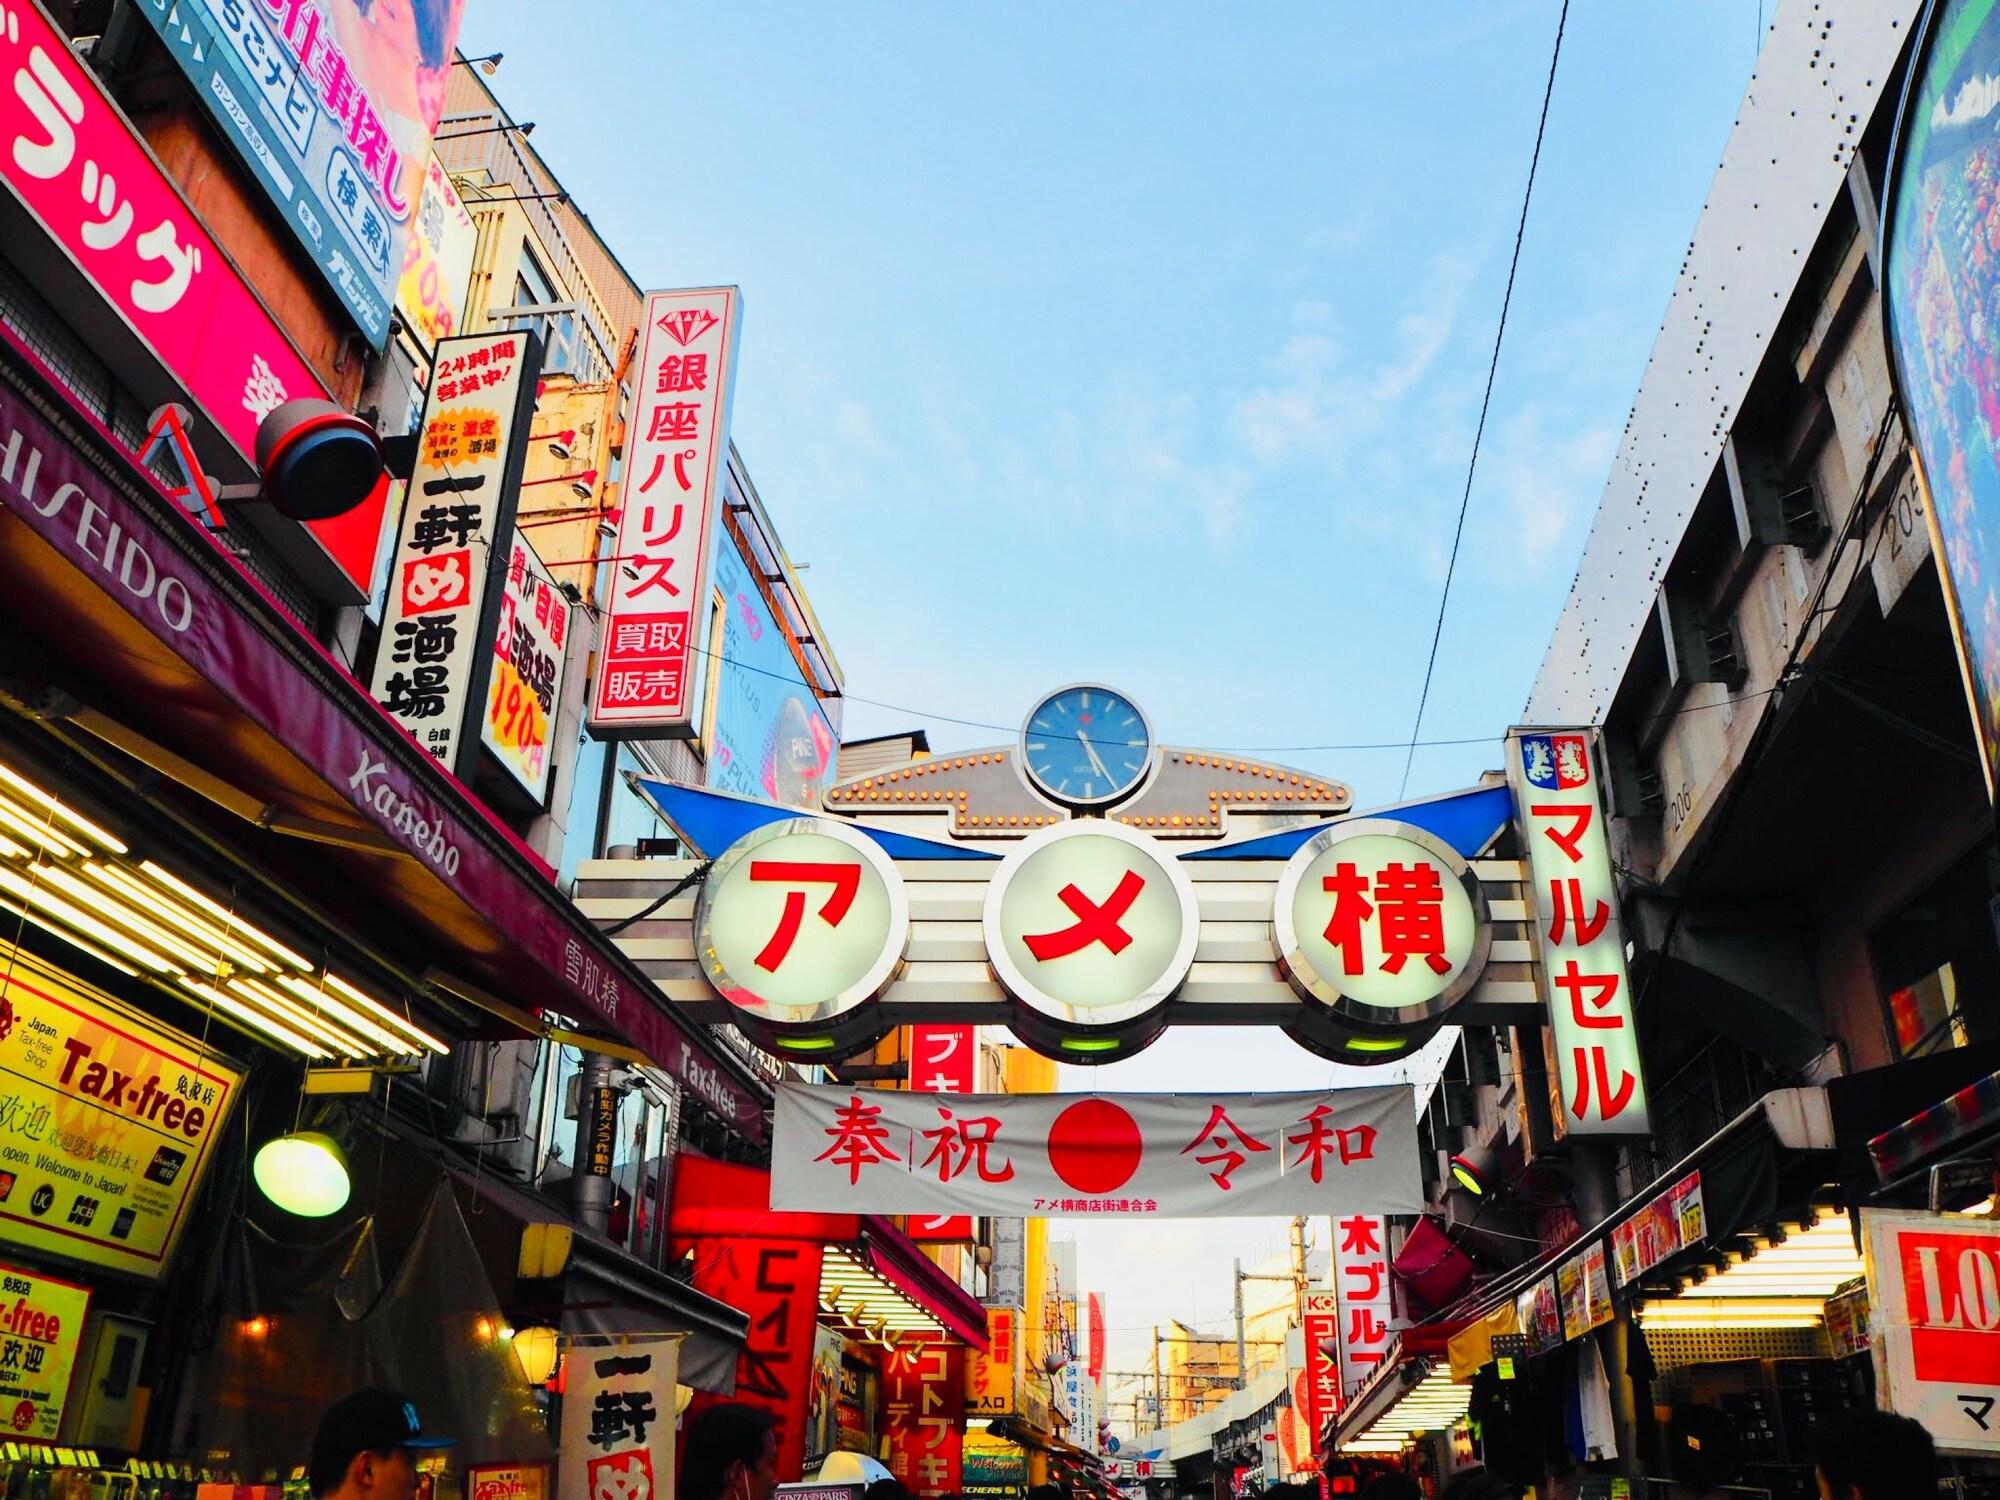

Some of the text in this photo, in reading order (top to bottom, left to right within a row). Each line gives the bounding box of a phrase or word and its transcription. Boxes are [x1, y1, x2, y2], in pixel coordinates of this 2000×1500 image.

[0, 3, 201, 313] ラッグ
[337, 167, 383, 254] 検索
[437, 365, 511, 402] 営業中!
[438, 340, 516, 380] 24時間
[625, 353, 708, 599] 銀座パリス
[381, 475, 485, 718] 一軒め酒場
[615, 622, 683, 652] 買取
[608, 670, 679, 702] 販売
[349, 751, 459, 877] Kanebo
[748, 860, 1452, 976] アメ横
[1531, 804, 1637, 1121] マルセル
[19, 1030, 54, 1055] Tax-free
[28, 1016, 58, 1039] Japan.
[24, 1050, 47, 1070] Shop
[59, 1037, 205, 1137] Tax-free
[681, 1042, 736, 1118] Tax-free
[814, 1096, 1378, 1191] 奉祝 令和
[35, 1155, 81, 1182] Welcome
[83, 1172, 94, 1186] to
[94, 1178, 127, 1198] Japan!
[1033, 1198, 1158, 1214] アメ横商店街連合会
[72, 1206, 95, 1219] JCB
[1914, 1246, 2000, 1330] LO
[1, 1339, 45, 1373] 欢迎
[587, 1354, 656, 1500] 一軒め
[981, 1396, 1006, 1409] 入口
